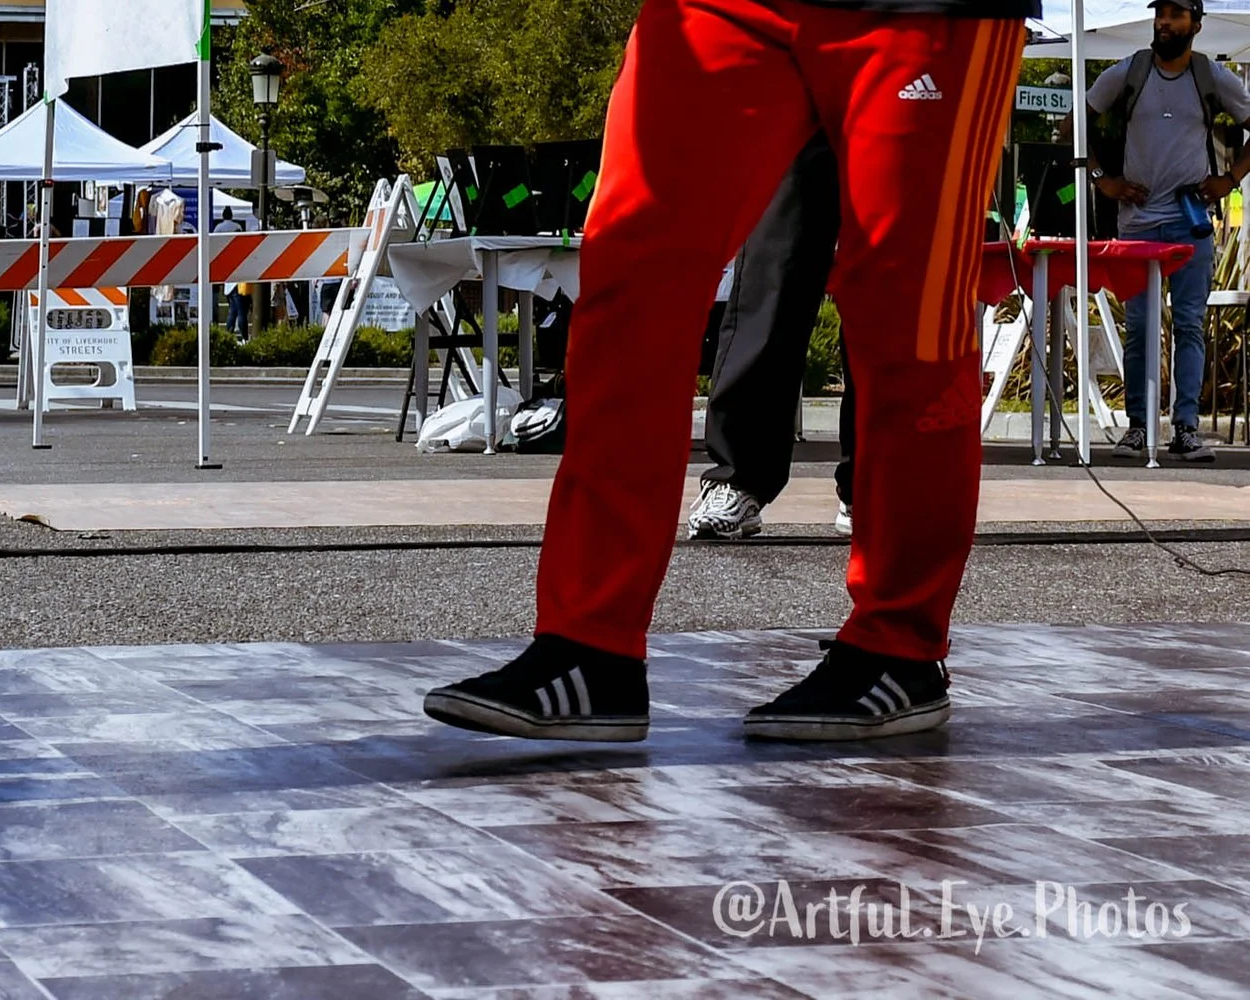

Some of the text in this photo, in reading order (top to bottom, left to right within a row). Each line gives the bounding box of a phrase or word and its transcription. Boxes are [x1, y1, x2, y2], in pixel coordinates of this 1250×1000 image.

[1019, 90, 1067, 108] First St.
[47, 337, 59, 345] ITY
[59, 345, 103, 355] STREETS
